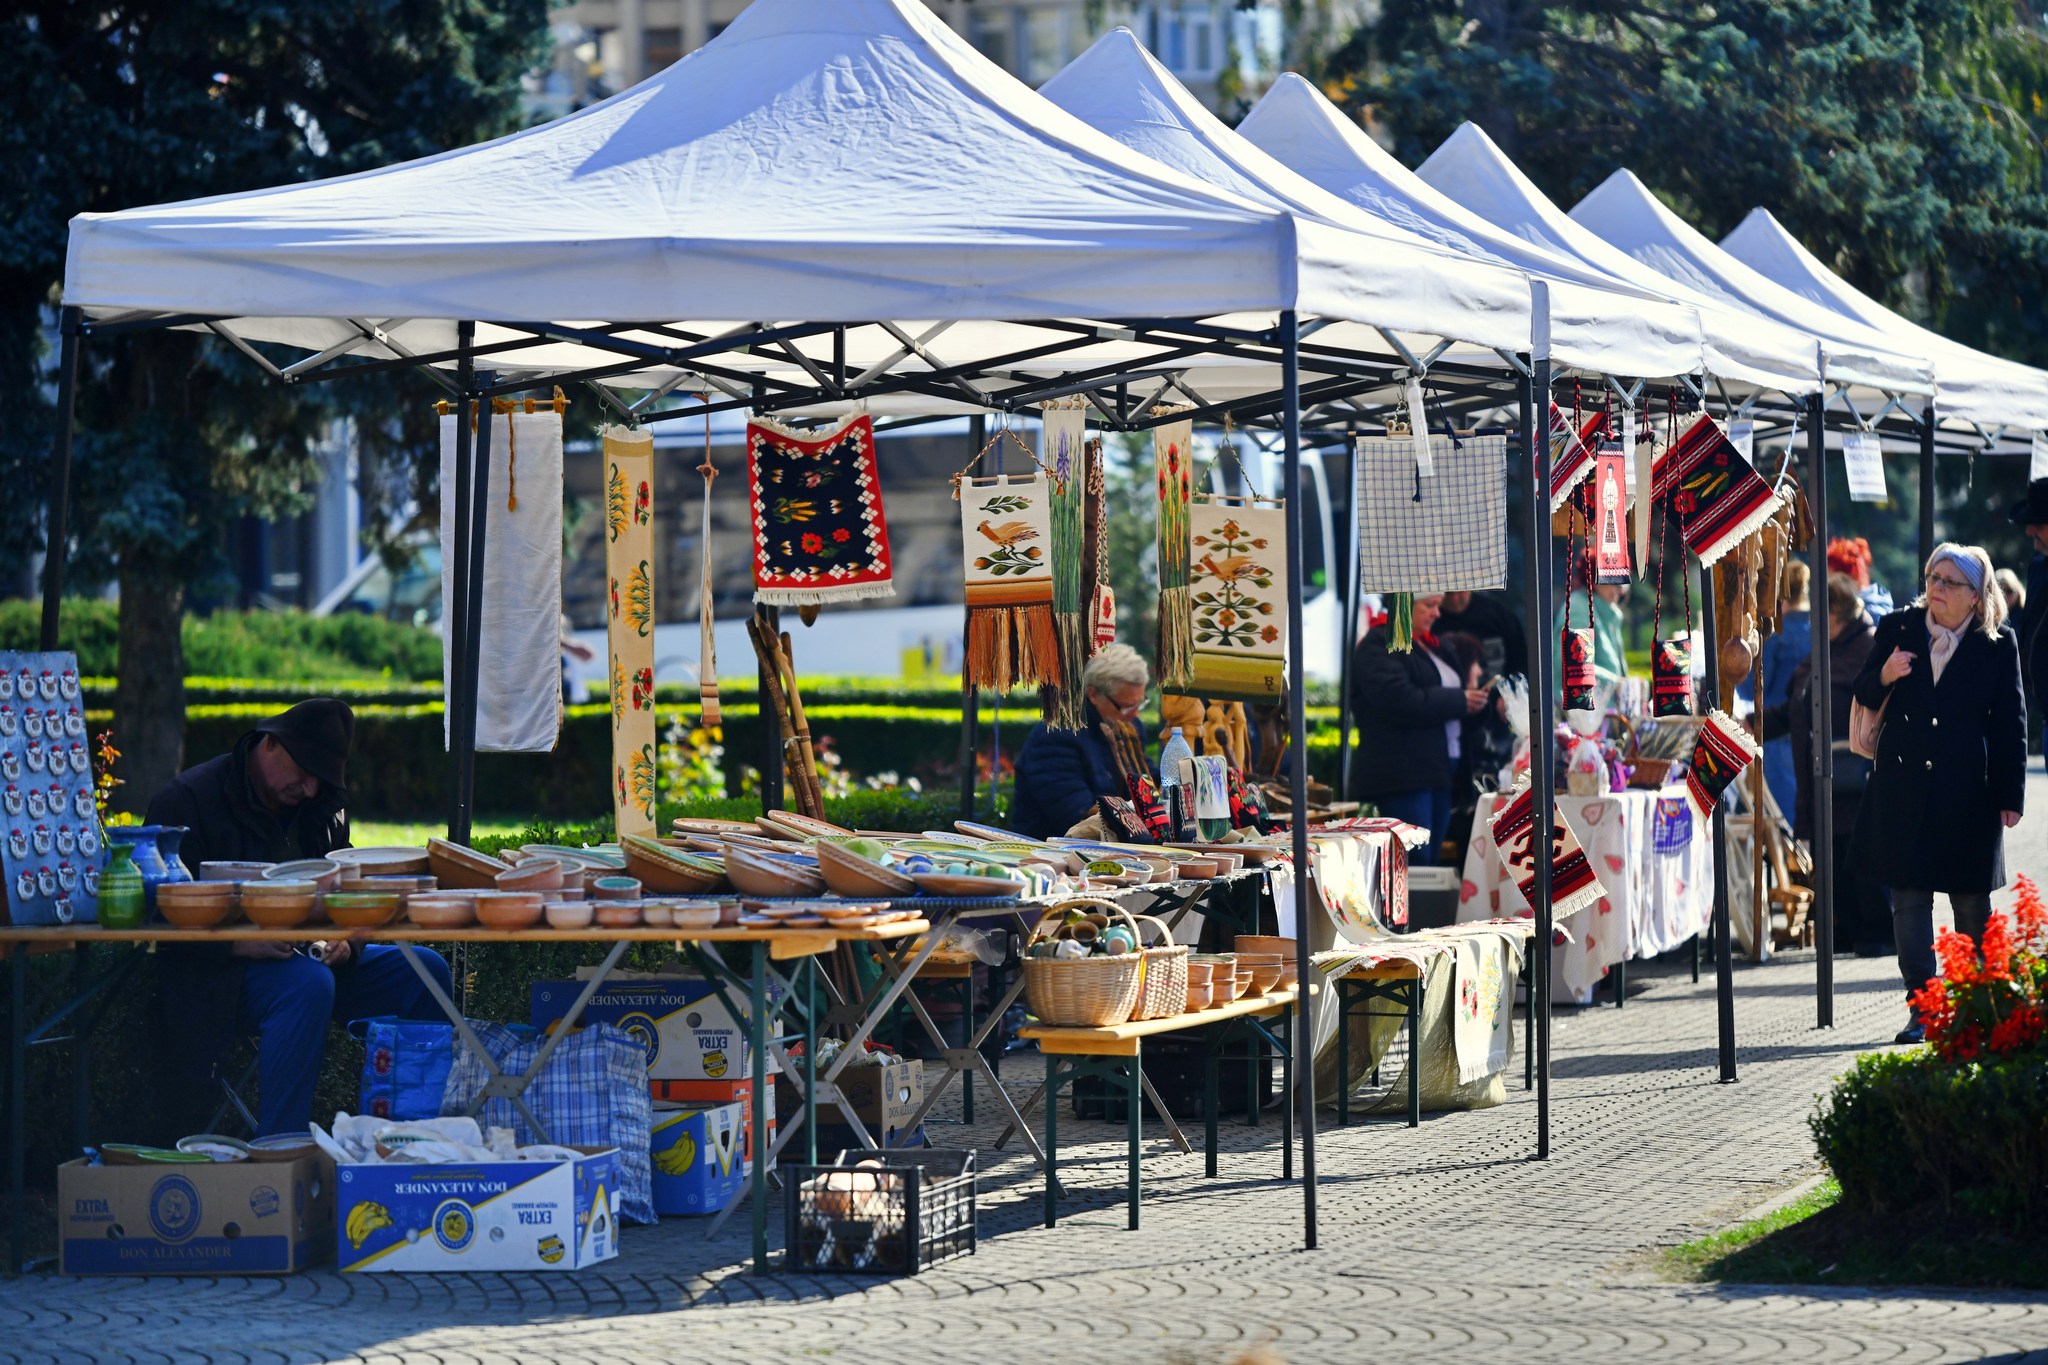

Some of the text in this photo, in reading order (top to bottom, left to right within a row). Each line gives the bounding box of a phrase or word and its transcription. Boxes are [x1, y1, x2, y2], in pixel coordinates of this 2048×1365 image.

[588, 995, 685, 1005] DON ALEXANDER
[698, 1037, 727, 1049] EXTRA
[395, 1181, 507, 1194] DON ALEXANDER
[76, 1199, 109, 1214] EXTRA
[517, 1210, 552, 1224] EXTRA
[120, 1246, 231, 1259] DON ALEXANDER
